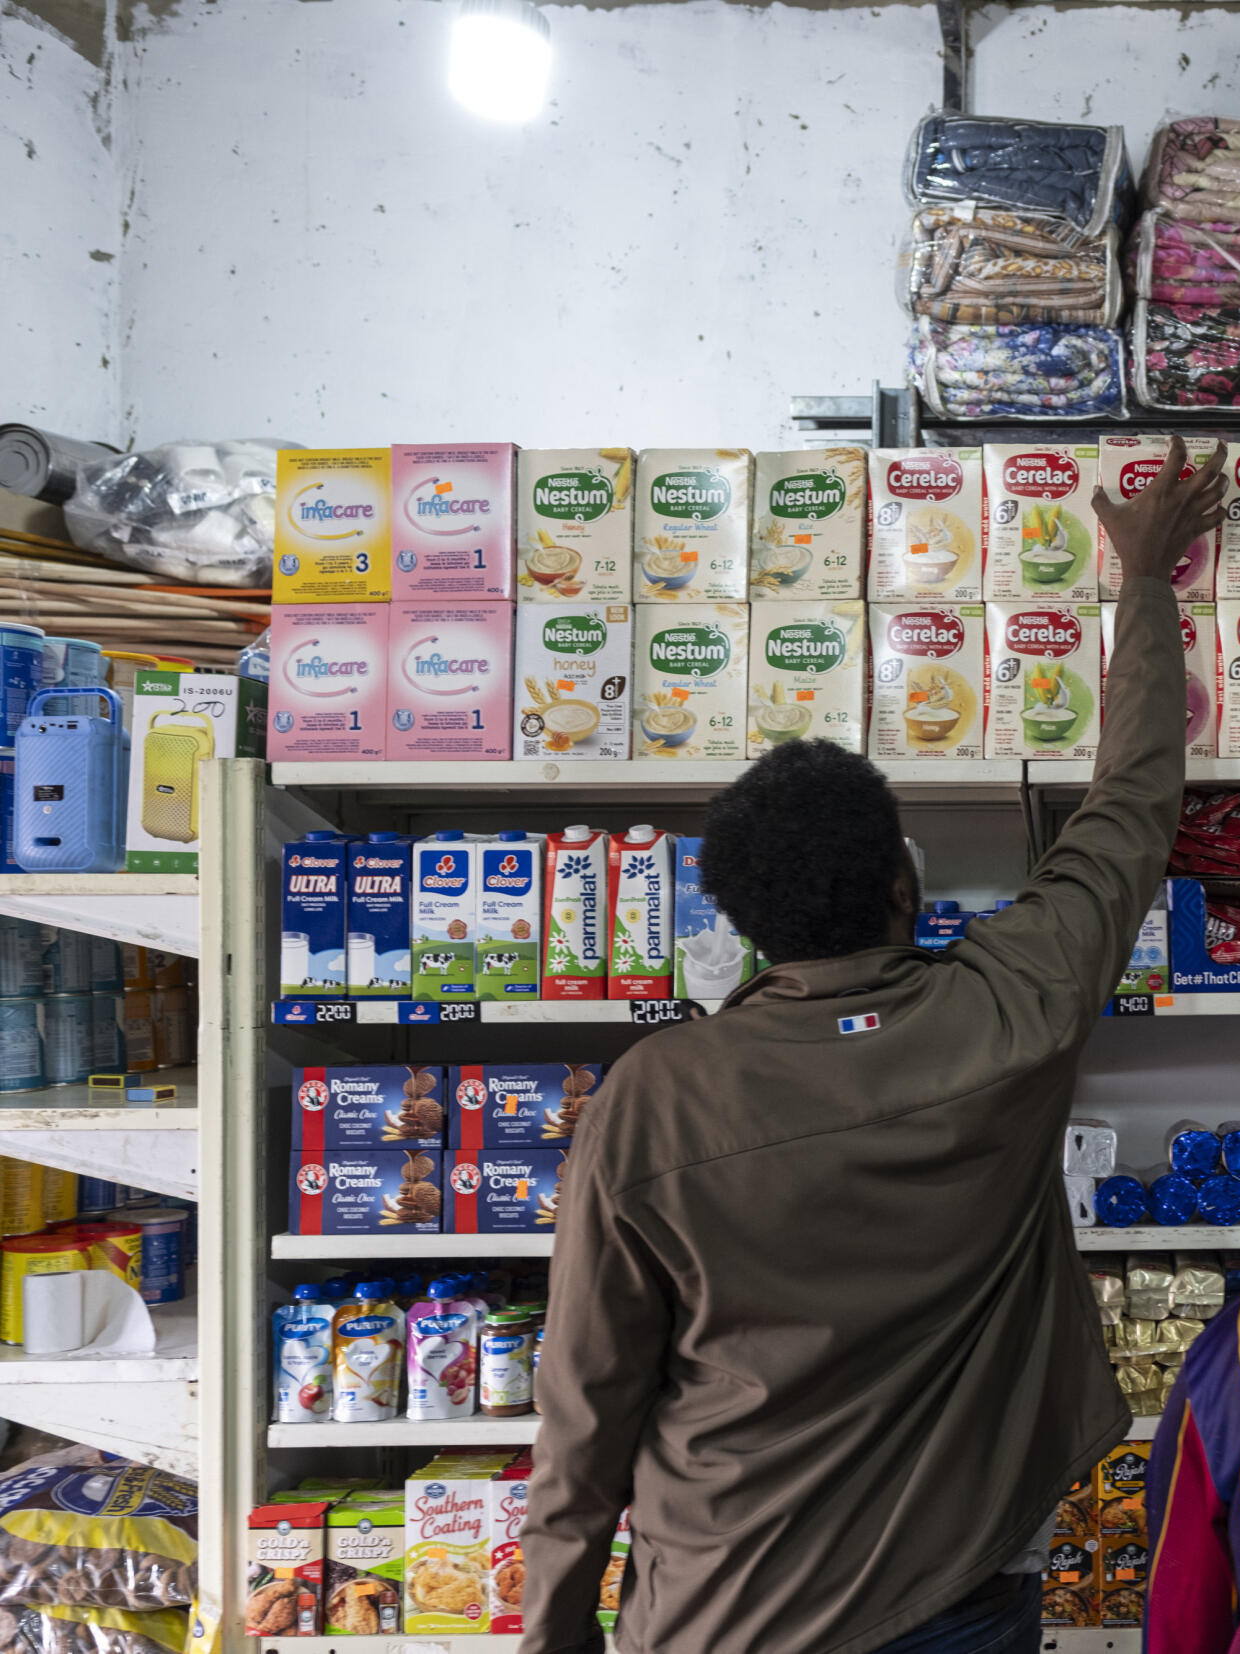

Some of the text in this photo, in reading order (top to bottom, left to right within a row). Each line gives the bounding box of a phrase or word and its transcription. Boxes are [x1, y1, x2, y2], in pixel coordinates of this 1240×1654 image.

[889, 471, 957, 487] Cerelac
[1005, 467, 1074, 485] Cerelac
[535, 488, 608, 505] Nestum
[653, 486, 725, 504] Nestum
[772, 489, 841, 506] Nestum
[300, 499, 374, 521] infacare
[416, 494, 491, 517] infacare
[355, 552, 369, 573] 3
[473, 549, 487, 569] 1
[594, 560, 616, 571] 7-12
[710, 560, 734, 571] 6-12
[824, 555, 847, 566] 6-12
[544, 628, 603, 642] Nestum
[890, 627, 958, 642] Cerelac
[1007, 625, 1076, 643] Cerelac
[652, 643, 725, 660] Nestum
[768, 640, 840, 657] Nestum
[296, 656, 368, 679] infacare
[415, 653, 489, 676] infacare
[553, 658, 596, 678] honey
[183, 687, 233, 696] IS-2006U
[349, 710, 362, 731] 1
[471, 709, 485, 730] 1
[709, 716, 733, 727] 6-12
[824, 712, 848, 723] 6-12
[302, 857, 340, 868] Clover
[366, 858, 404, 869] Clover
[289, 875, 337, 893] ULTRA
[354, 875, 402, 893] ULTRA
[422, 876, 466, 888] Clover
[486, 875, 530, 888] Clover
[580, 872, 600, 960] parmalat
[645, 872, 665, 960] parmalat
[331, 1079, 379, 1094] Romany
[488, 1078, 538, 1093] Romany
[337, 1092, 385, 1106] Creams
[329, 1163, 377, 1177] Romany
[483, 1162, 533, 1177] Romany
[335, 1176, 382, 1190] Creams
[284, 1322, 324, 1332] PURITY
[346, 1320, 390, 1331] PURITY
[410, 1491, 484, 1523] Southern
[420, 1515, 482, 1540] Coating
[257, 1548, 312, 1561] CRISPY
[336, 1547, 392, 1560] CRISPY
